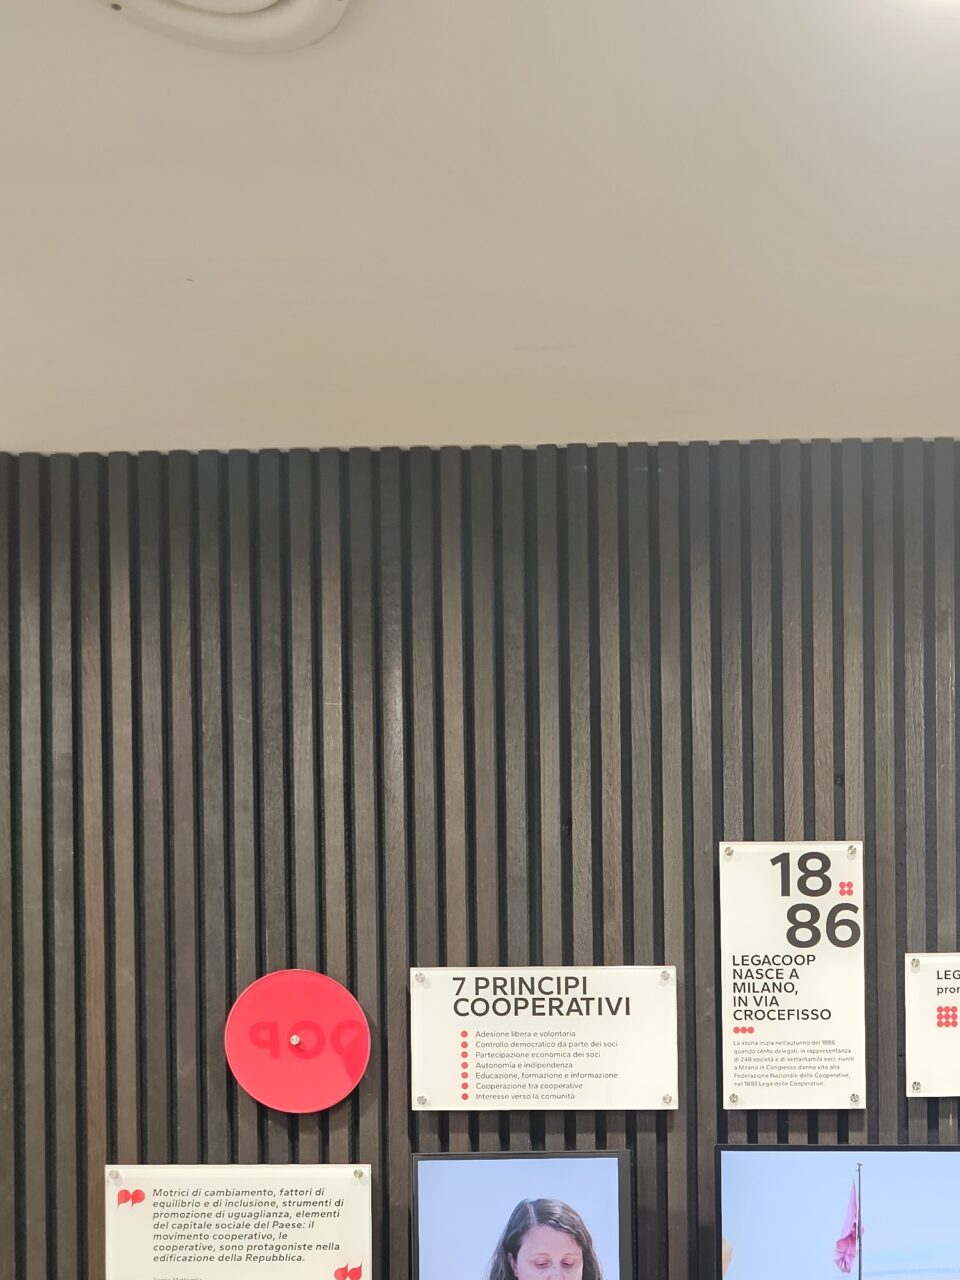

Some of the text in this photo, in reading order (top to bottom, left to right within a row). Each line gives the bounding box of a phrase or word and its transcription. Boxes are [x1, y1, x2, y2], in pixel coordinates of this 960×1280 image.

[770, 852, 832, 897] 18
[786, 903, 861, 948] 86
[732, 954, 816, 966] LEGACOOP
[733, 968, 799, 980] NASCE A
[452, 976, 587, 996] 7 PRINCIPI
[733, 982, 798, 995] MILANO,
[453, 997, 630, 1017] COOPERATIVI
[733, 996, 779, 1007] IN VIA
[733, 1009, 831, 1021] CROCEFISSO
[153, 1188, 325, 1198] Motrici di cambiamento, fattori di
